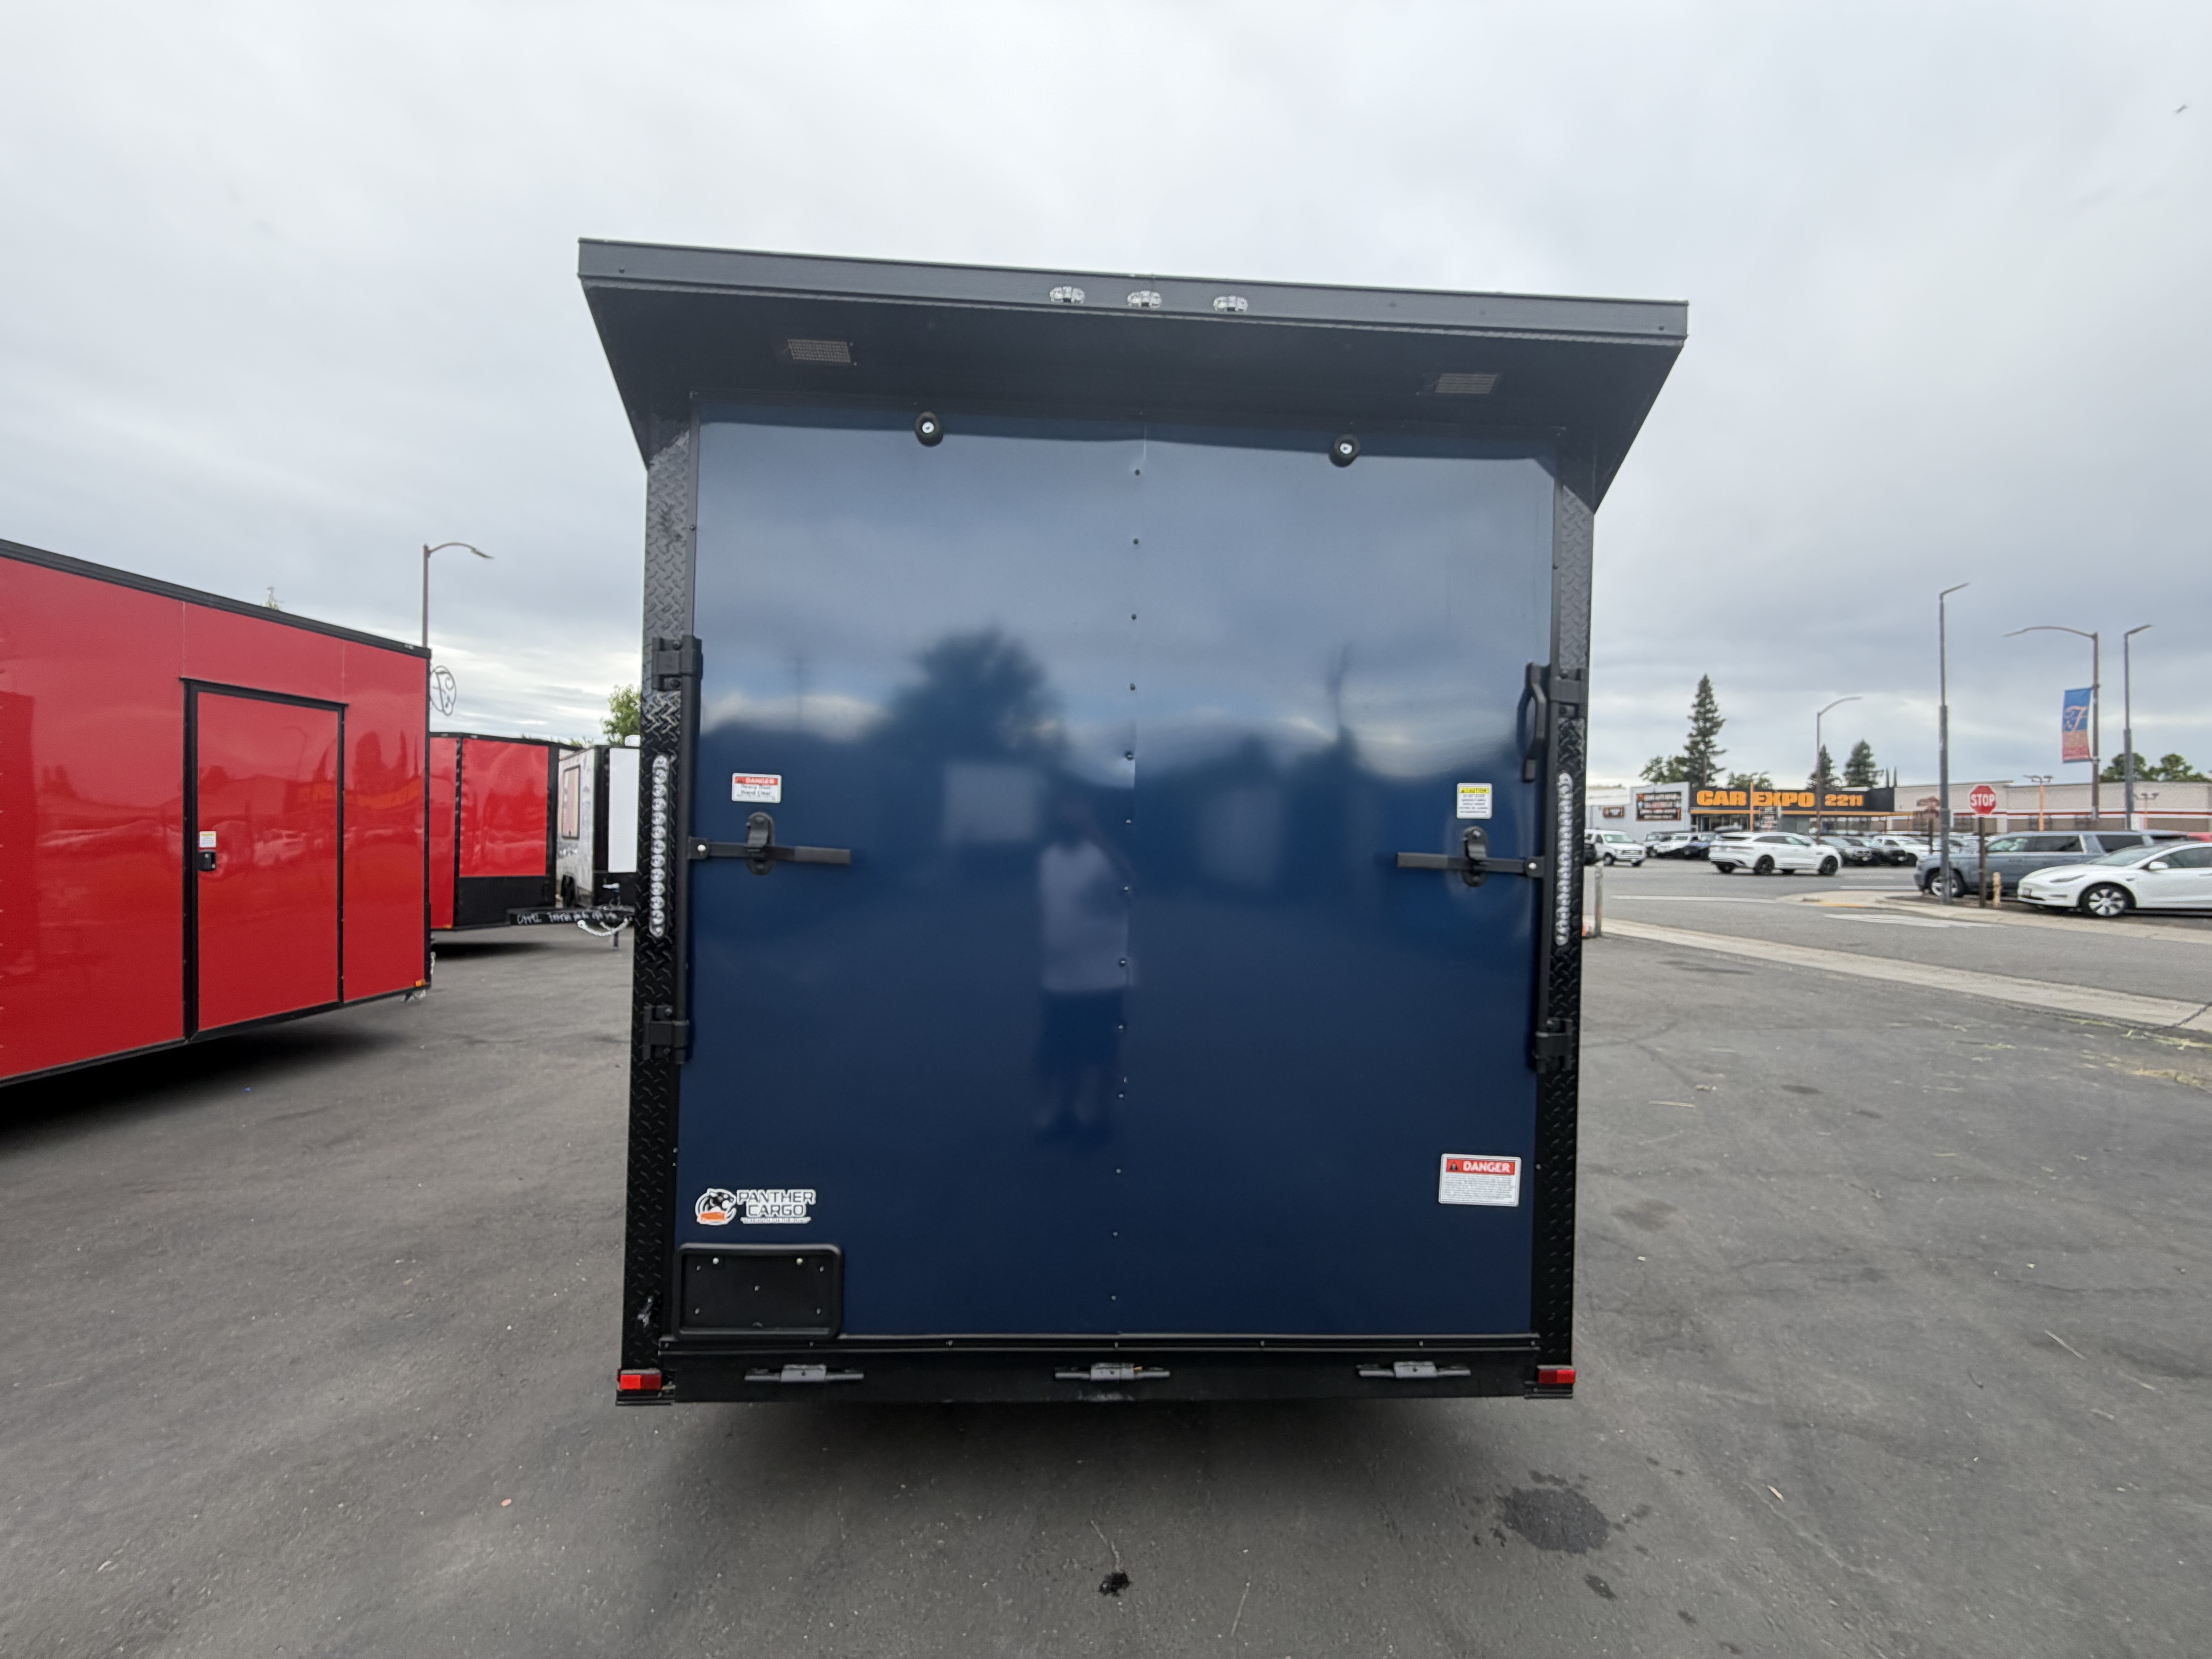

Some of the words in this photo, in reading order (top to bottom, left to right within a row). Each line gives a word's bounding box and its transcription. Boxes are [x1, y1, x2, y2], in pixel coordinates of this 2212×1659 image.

[1697, 790, 1747, 806] CAR
[1753, 791, 1815, 807] EXPO
[1824, 794, 1864, 807] 2211
[1970, 794, 1996, 807] STOP
[1463, 1161, 1510, 1173] DANGER
[738, 1191, 814, 1203] PANTHER
[748, 1204, 805, 1216] CARGO
